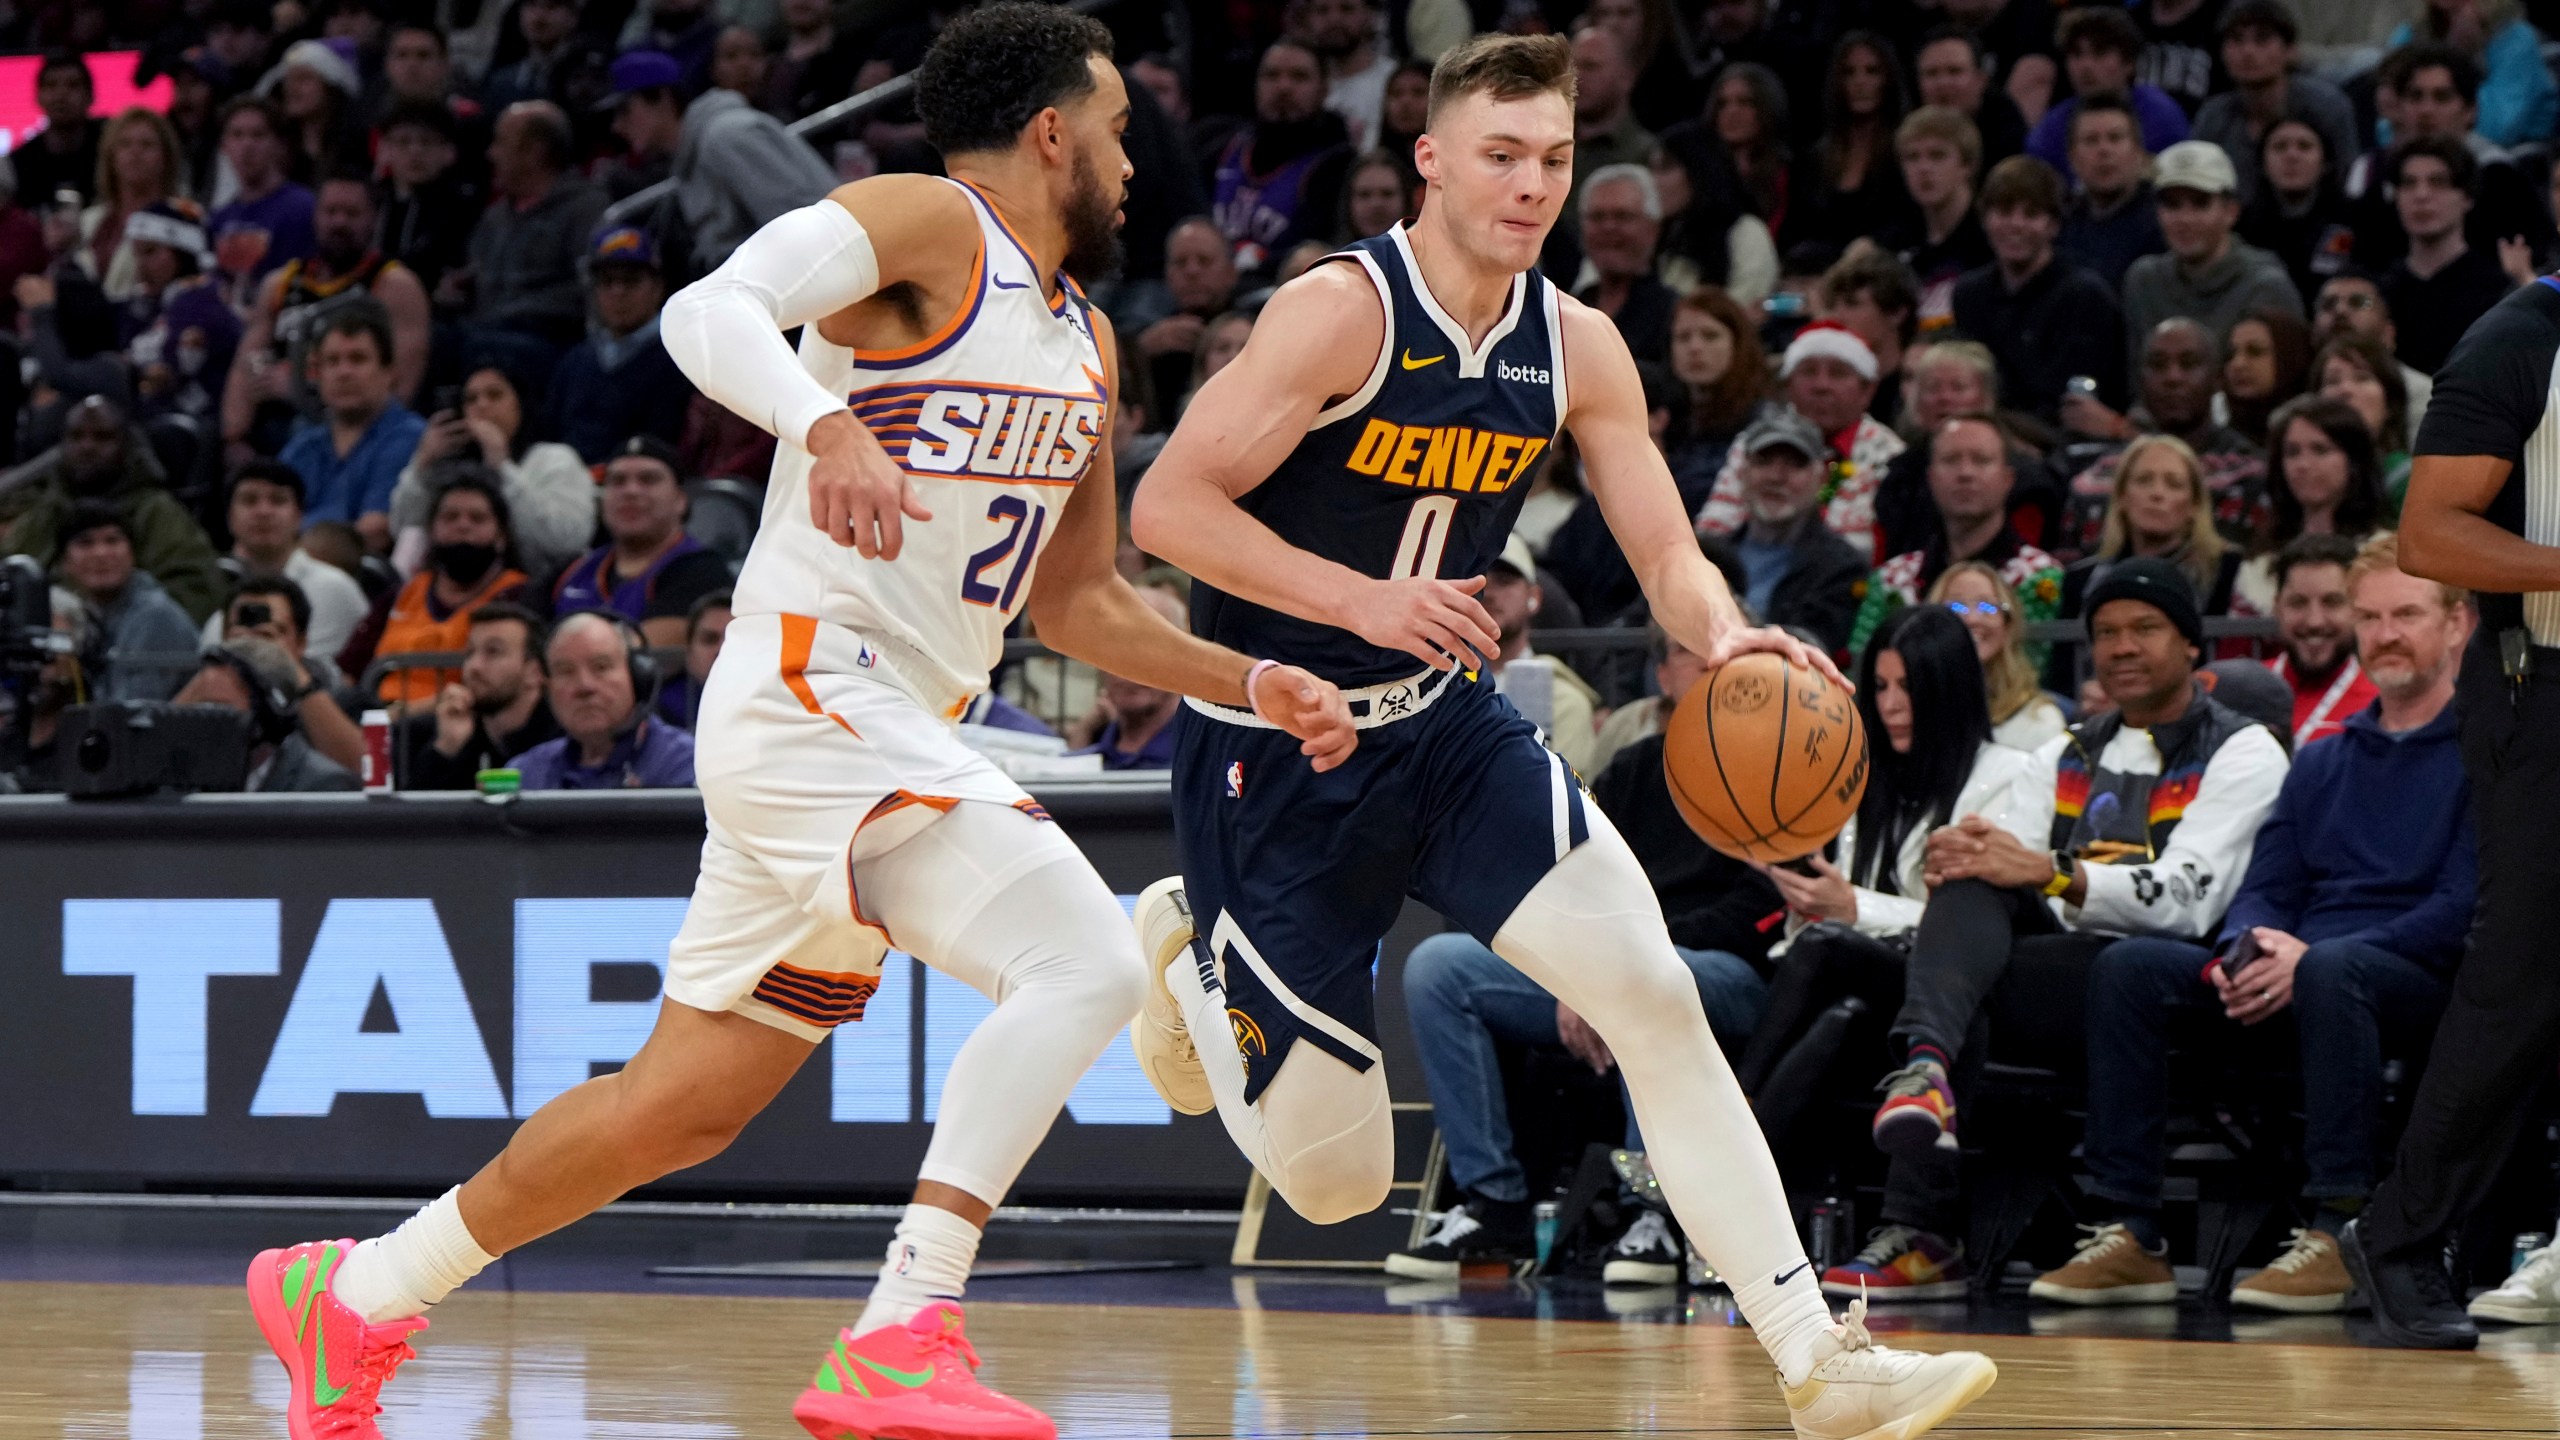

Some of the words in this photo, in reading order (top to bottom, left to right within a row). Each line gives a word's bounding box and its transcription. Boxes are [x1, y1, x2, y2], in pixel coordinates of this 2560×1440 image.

[1497, 359, 1550, 384] ibotta
[906, 389, 1101, 479] SUNS
[1345, 417, 1549, 494] DENVER
[961, 493, 1046, 615] 21
[1389, 494, 1459, 581] 0
[62, 896, 691, 1119] TAP
[831, 894, 1173, 1125] I
